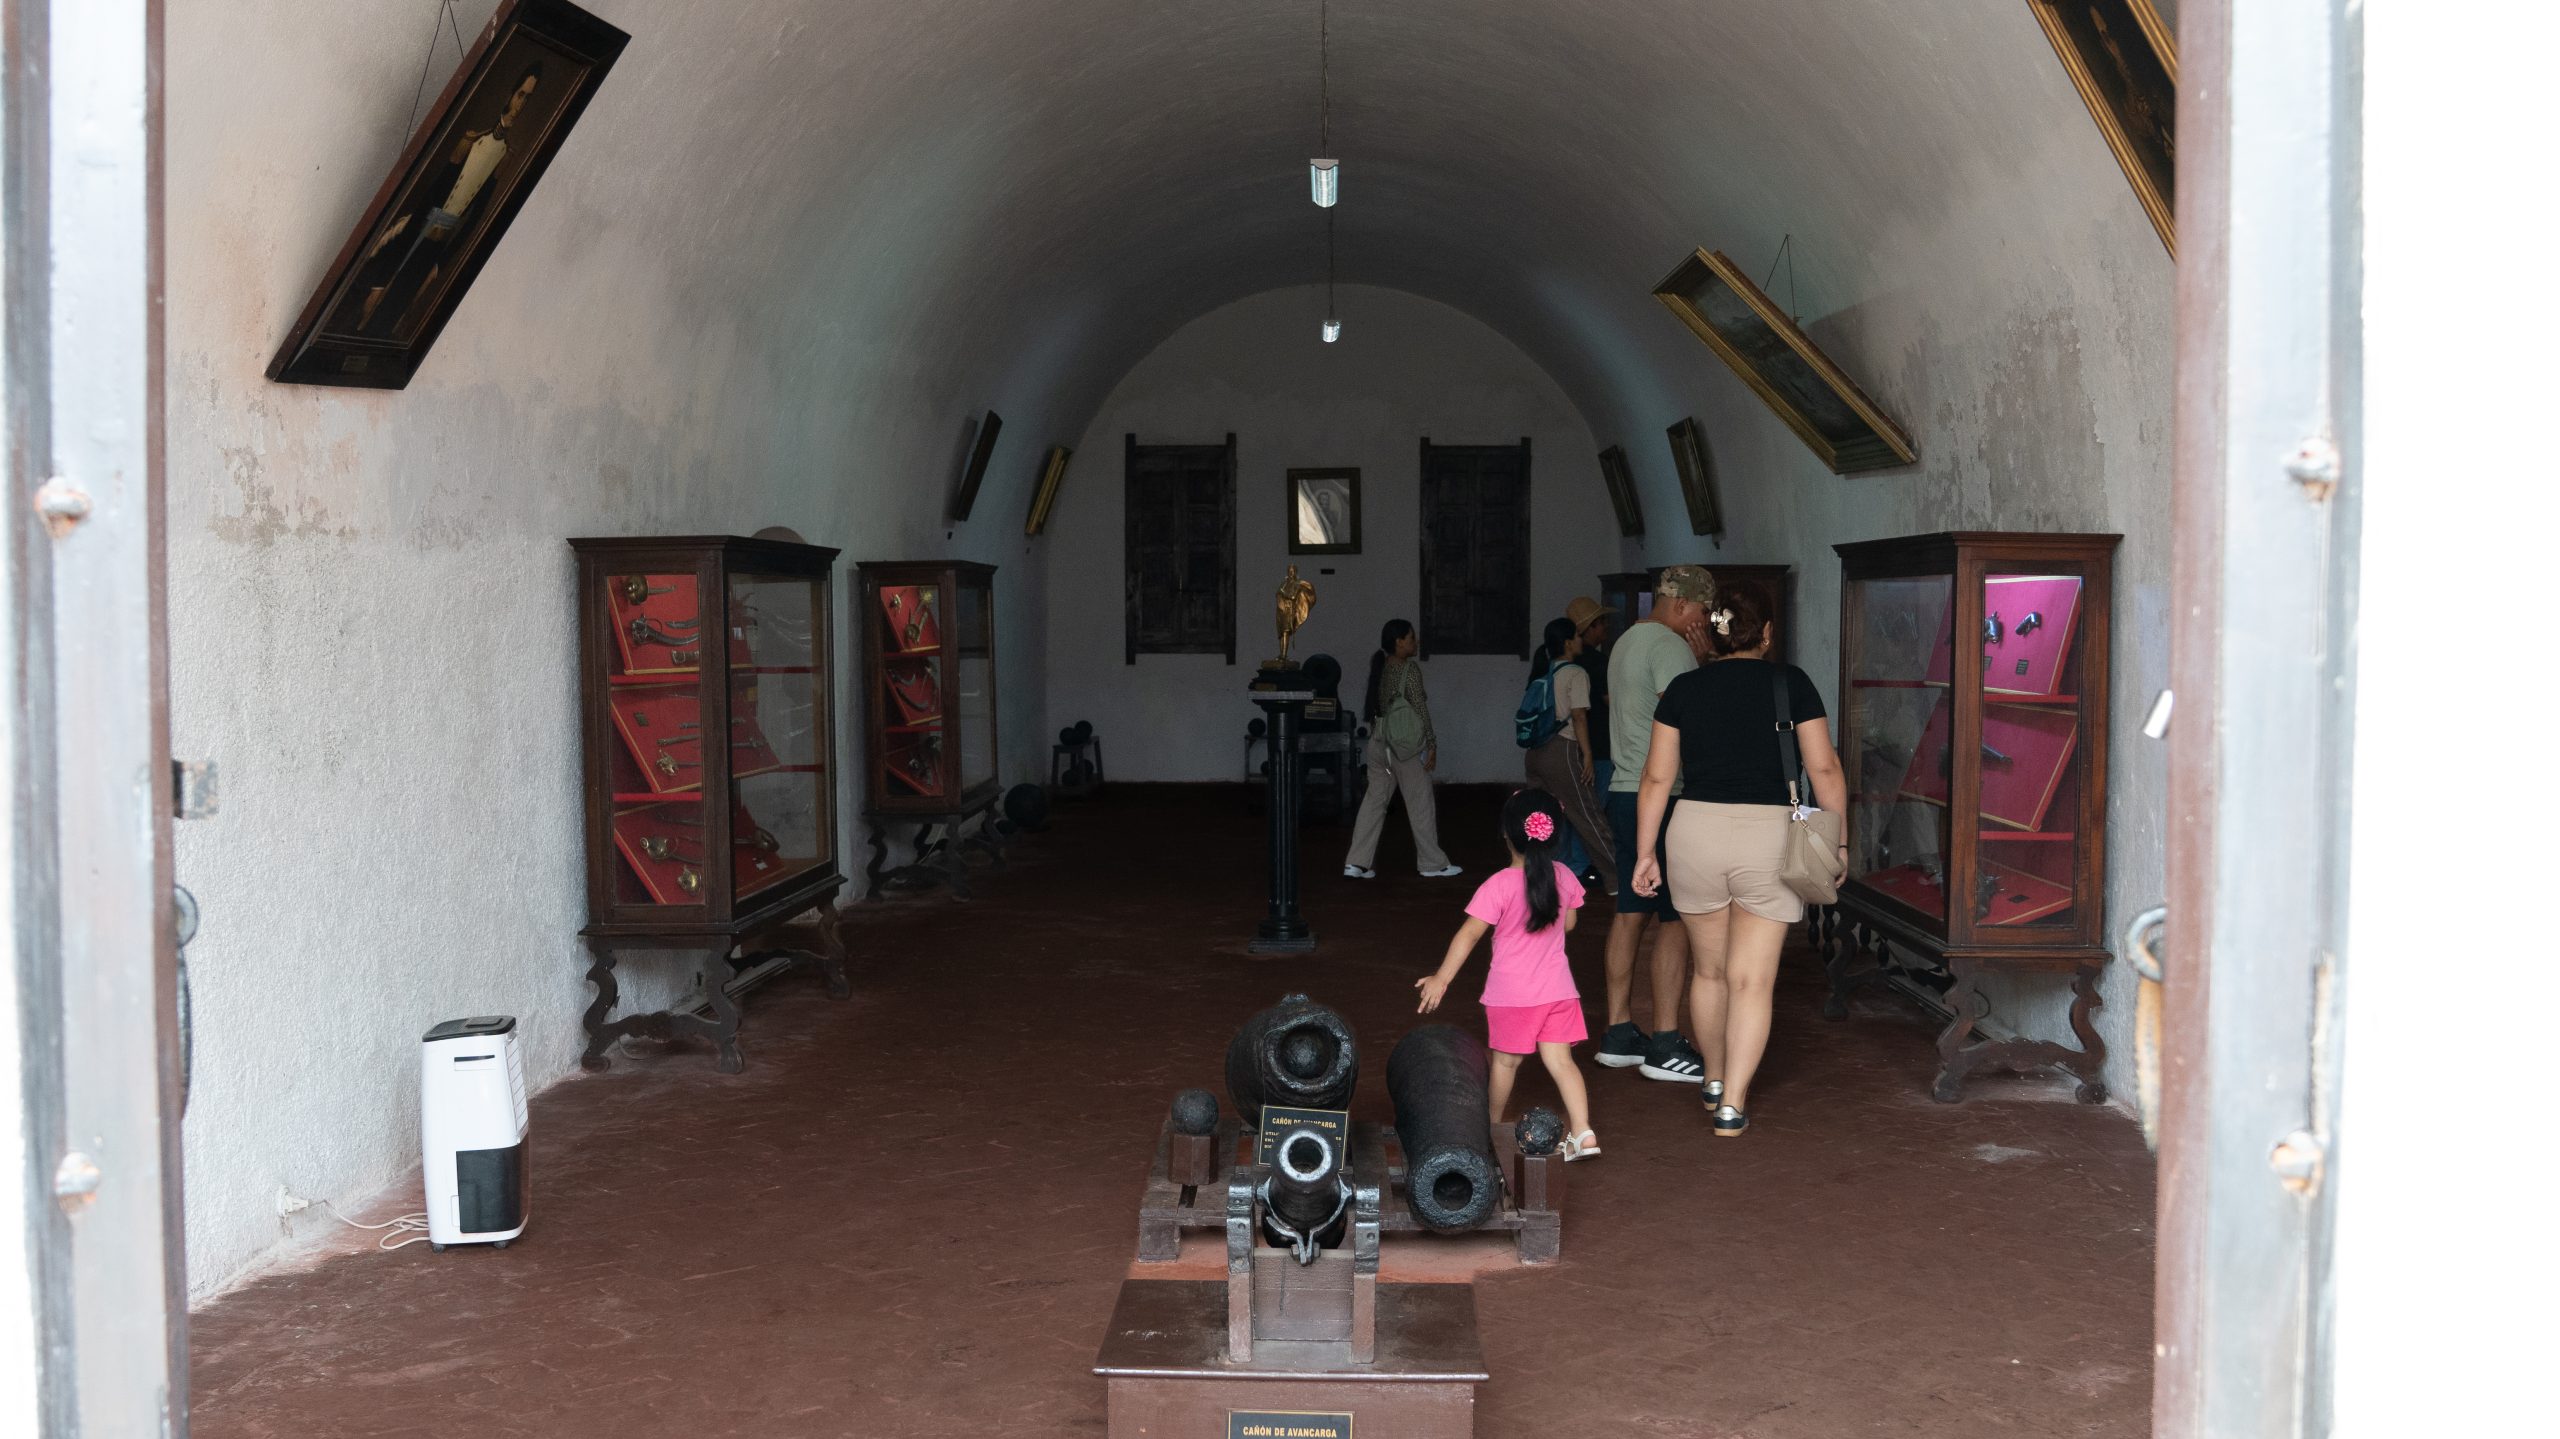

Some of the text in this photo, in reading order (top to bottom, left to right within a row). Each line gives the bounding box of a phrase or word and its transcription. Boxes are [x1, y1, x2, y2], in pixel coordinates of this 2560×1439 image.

[1272, 1117, 1292, 1125] CAÑÓN
[1243, 1425, 1337, 1438] CAÑÓN DE AVANCARGA
